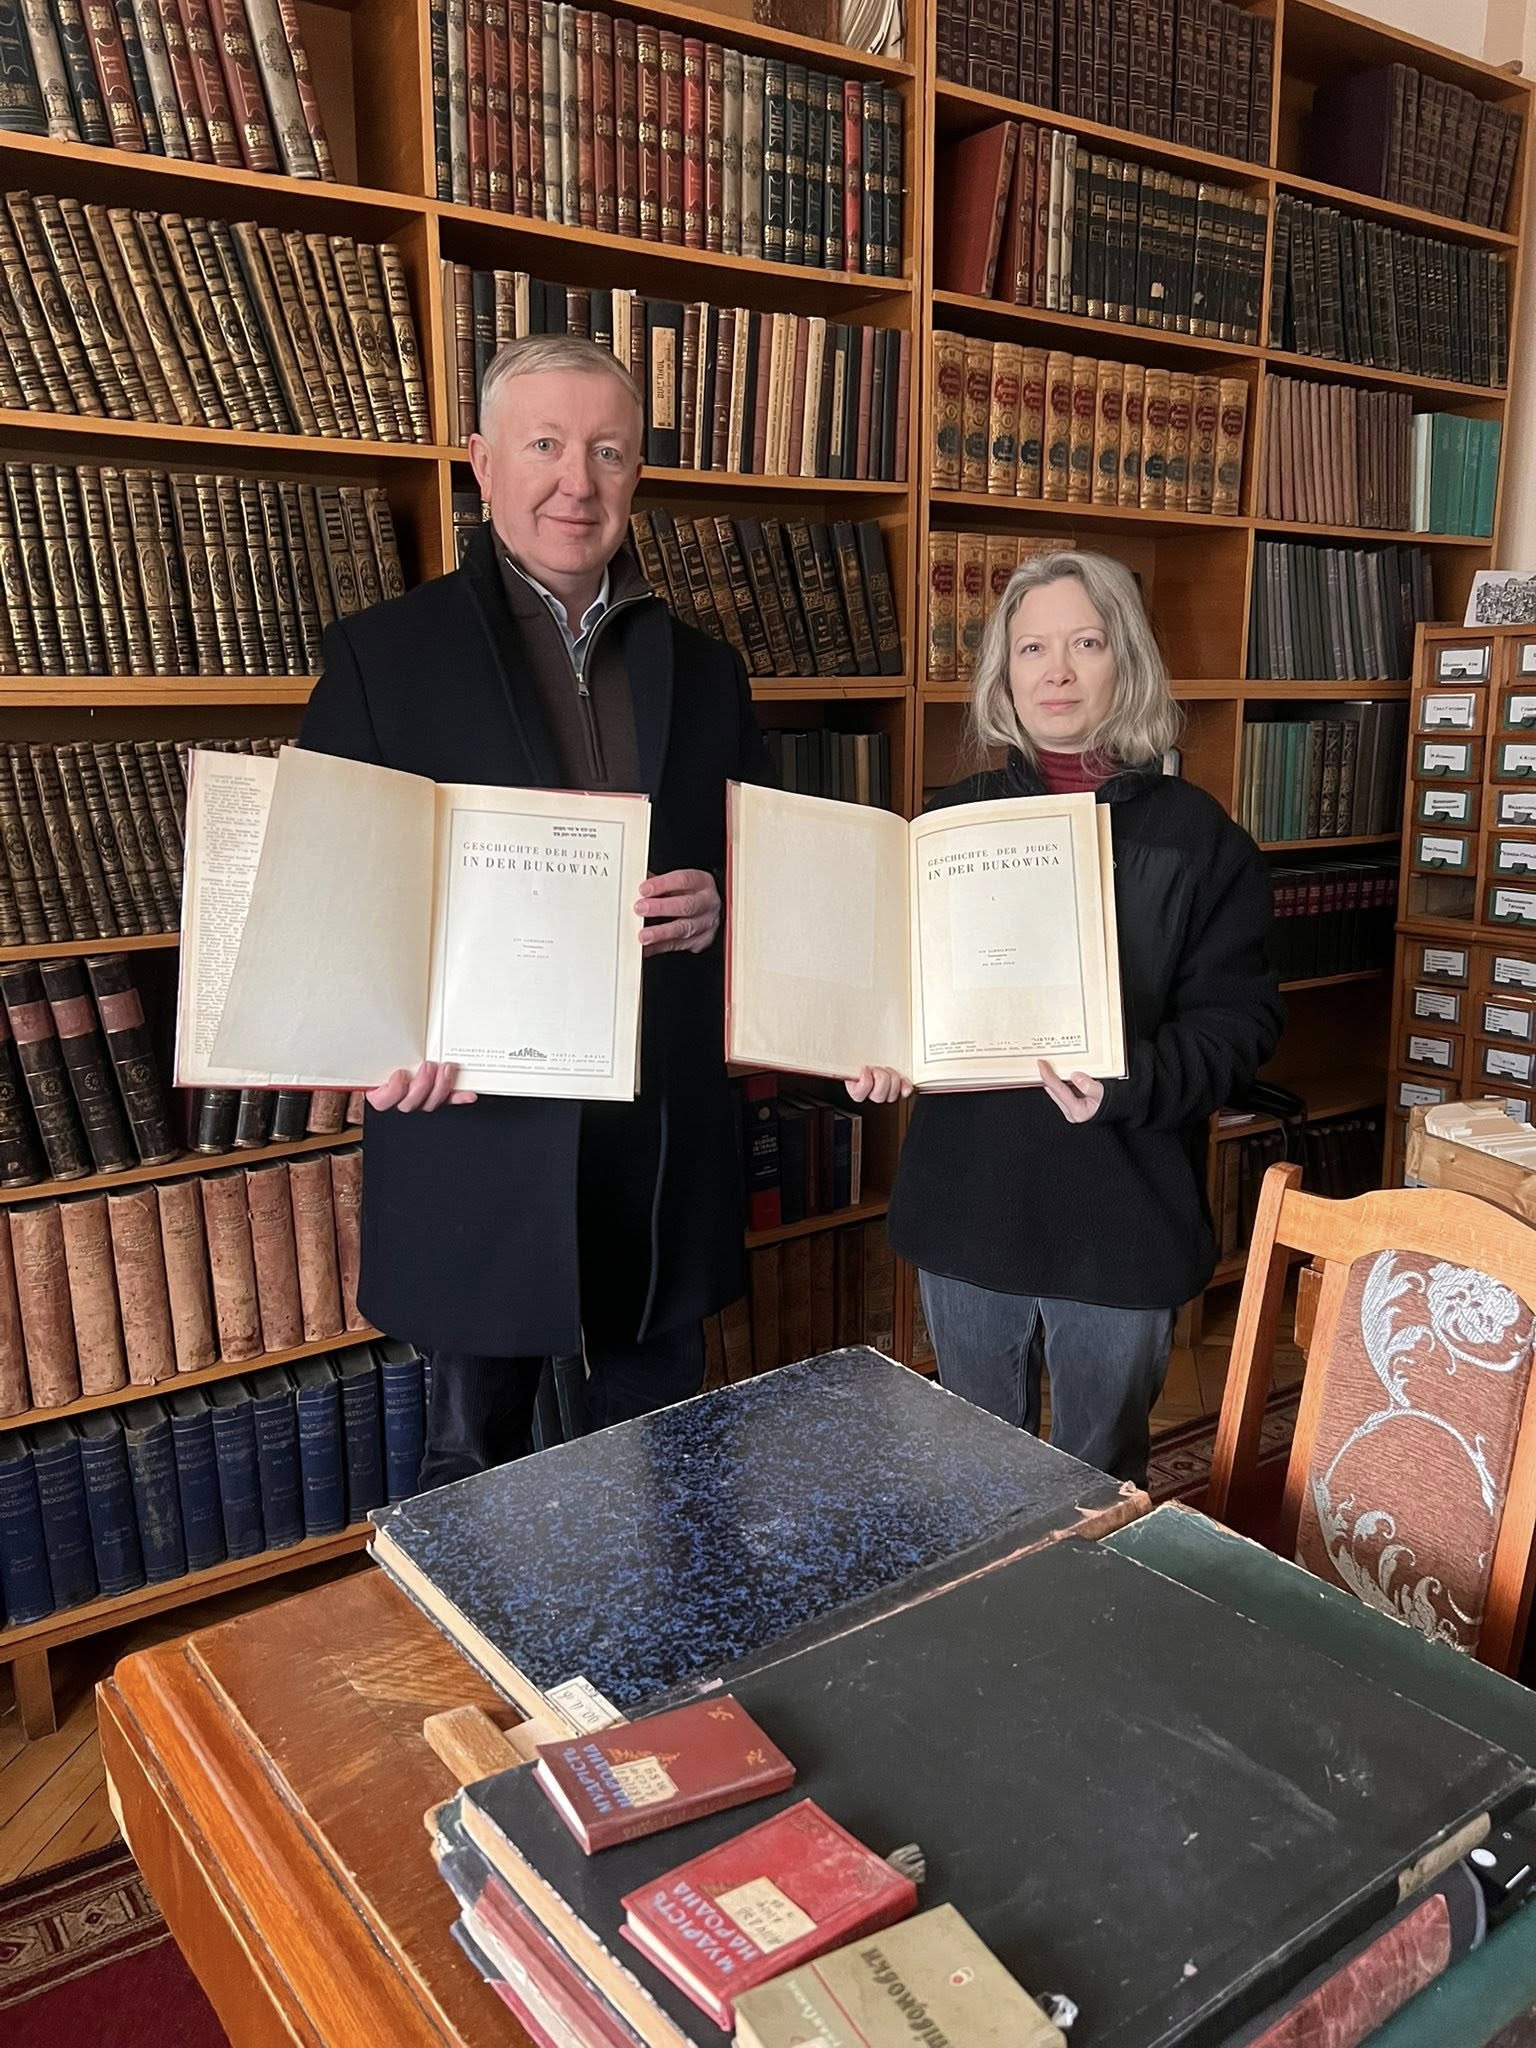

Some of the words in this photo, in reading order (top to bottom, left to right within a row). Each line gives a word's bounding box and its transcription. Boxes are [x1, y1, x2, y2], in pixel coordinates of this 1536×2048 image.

[462, 855, 480, 868] IN
[485, 857, 517, 871] DER
[523, 859, 610, 878] BUKOWINA
[463, 841, 540, 856] GESCHICHTE
[545, 847, 568, 858] DER
[572, 849, 611, 862] JUDEN
[927, 849, 989, 867] GESCHICHTE
[996, 846, 1018, 856] DER
[1024, 842, 1060, 854] JUDEN
[928, 867, 942, 881] IN
[948, 863, 975, 877] DER
[982, 854, 1061, 873] BUKOWINA
[561, 1745, 613, 1815] МУДРІСТЬ
[581, 1742, 633, 1810] НАРОДНА
[652, 1886, 735, 1976] МУДРІСТЬ
[672, 1879, 760, 1962] НАРОДНА
[860, 1944, 952, 2048] півомовки
